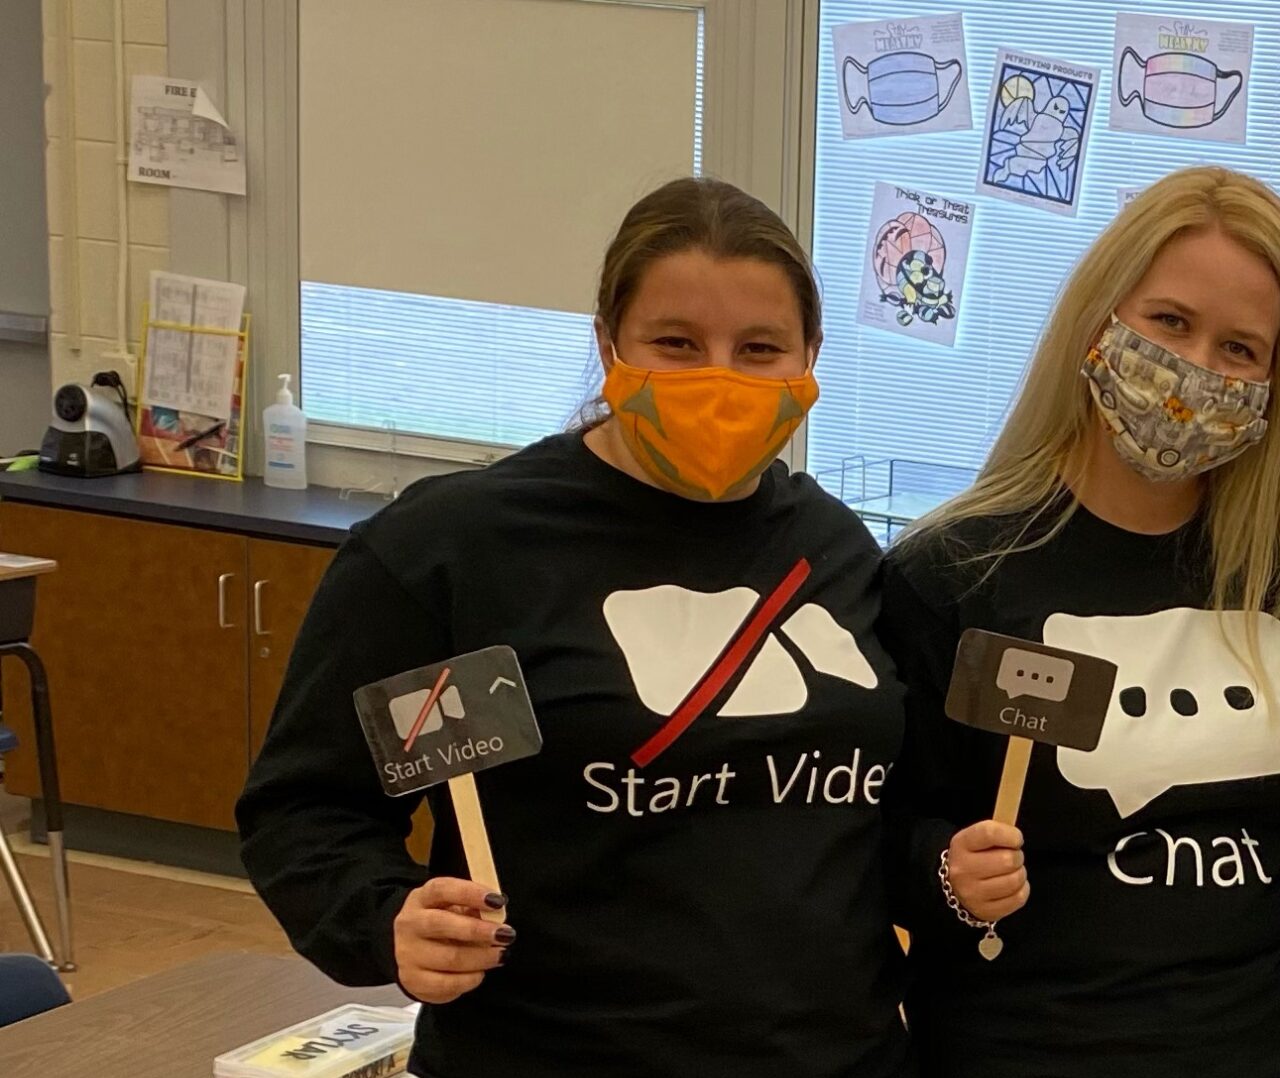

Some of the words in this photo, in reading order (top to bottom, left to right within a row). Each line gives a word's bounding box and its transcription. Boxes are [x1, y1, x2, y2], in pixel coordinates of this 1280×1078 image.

[1053, 64, 1092, 80] PRODUCTS
[165, 85, 188, 97] FIRE
[139, 167, 171, 179] ROOM
[896, 186, 920, 202] Trick
[925, 196, 938, 205] or
[942, 198, 970, 214] Treat
[917, 202, 968, 224] Treasures
[1000, 707, 1048, 732] Chat
[384, 754, 434, 784] Start
[436, 736, 504, 766] Video
[582, 761, 737, 817] Start
[766, 748, 894, 805] Vide
[280, 1024, 379, 1060] SKYLAR
